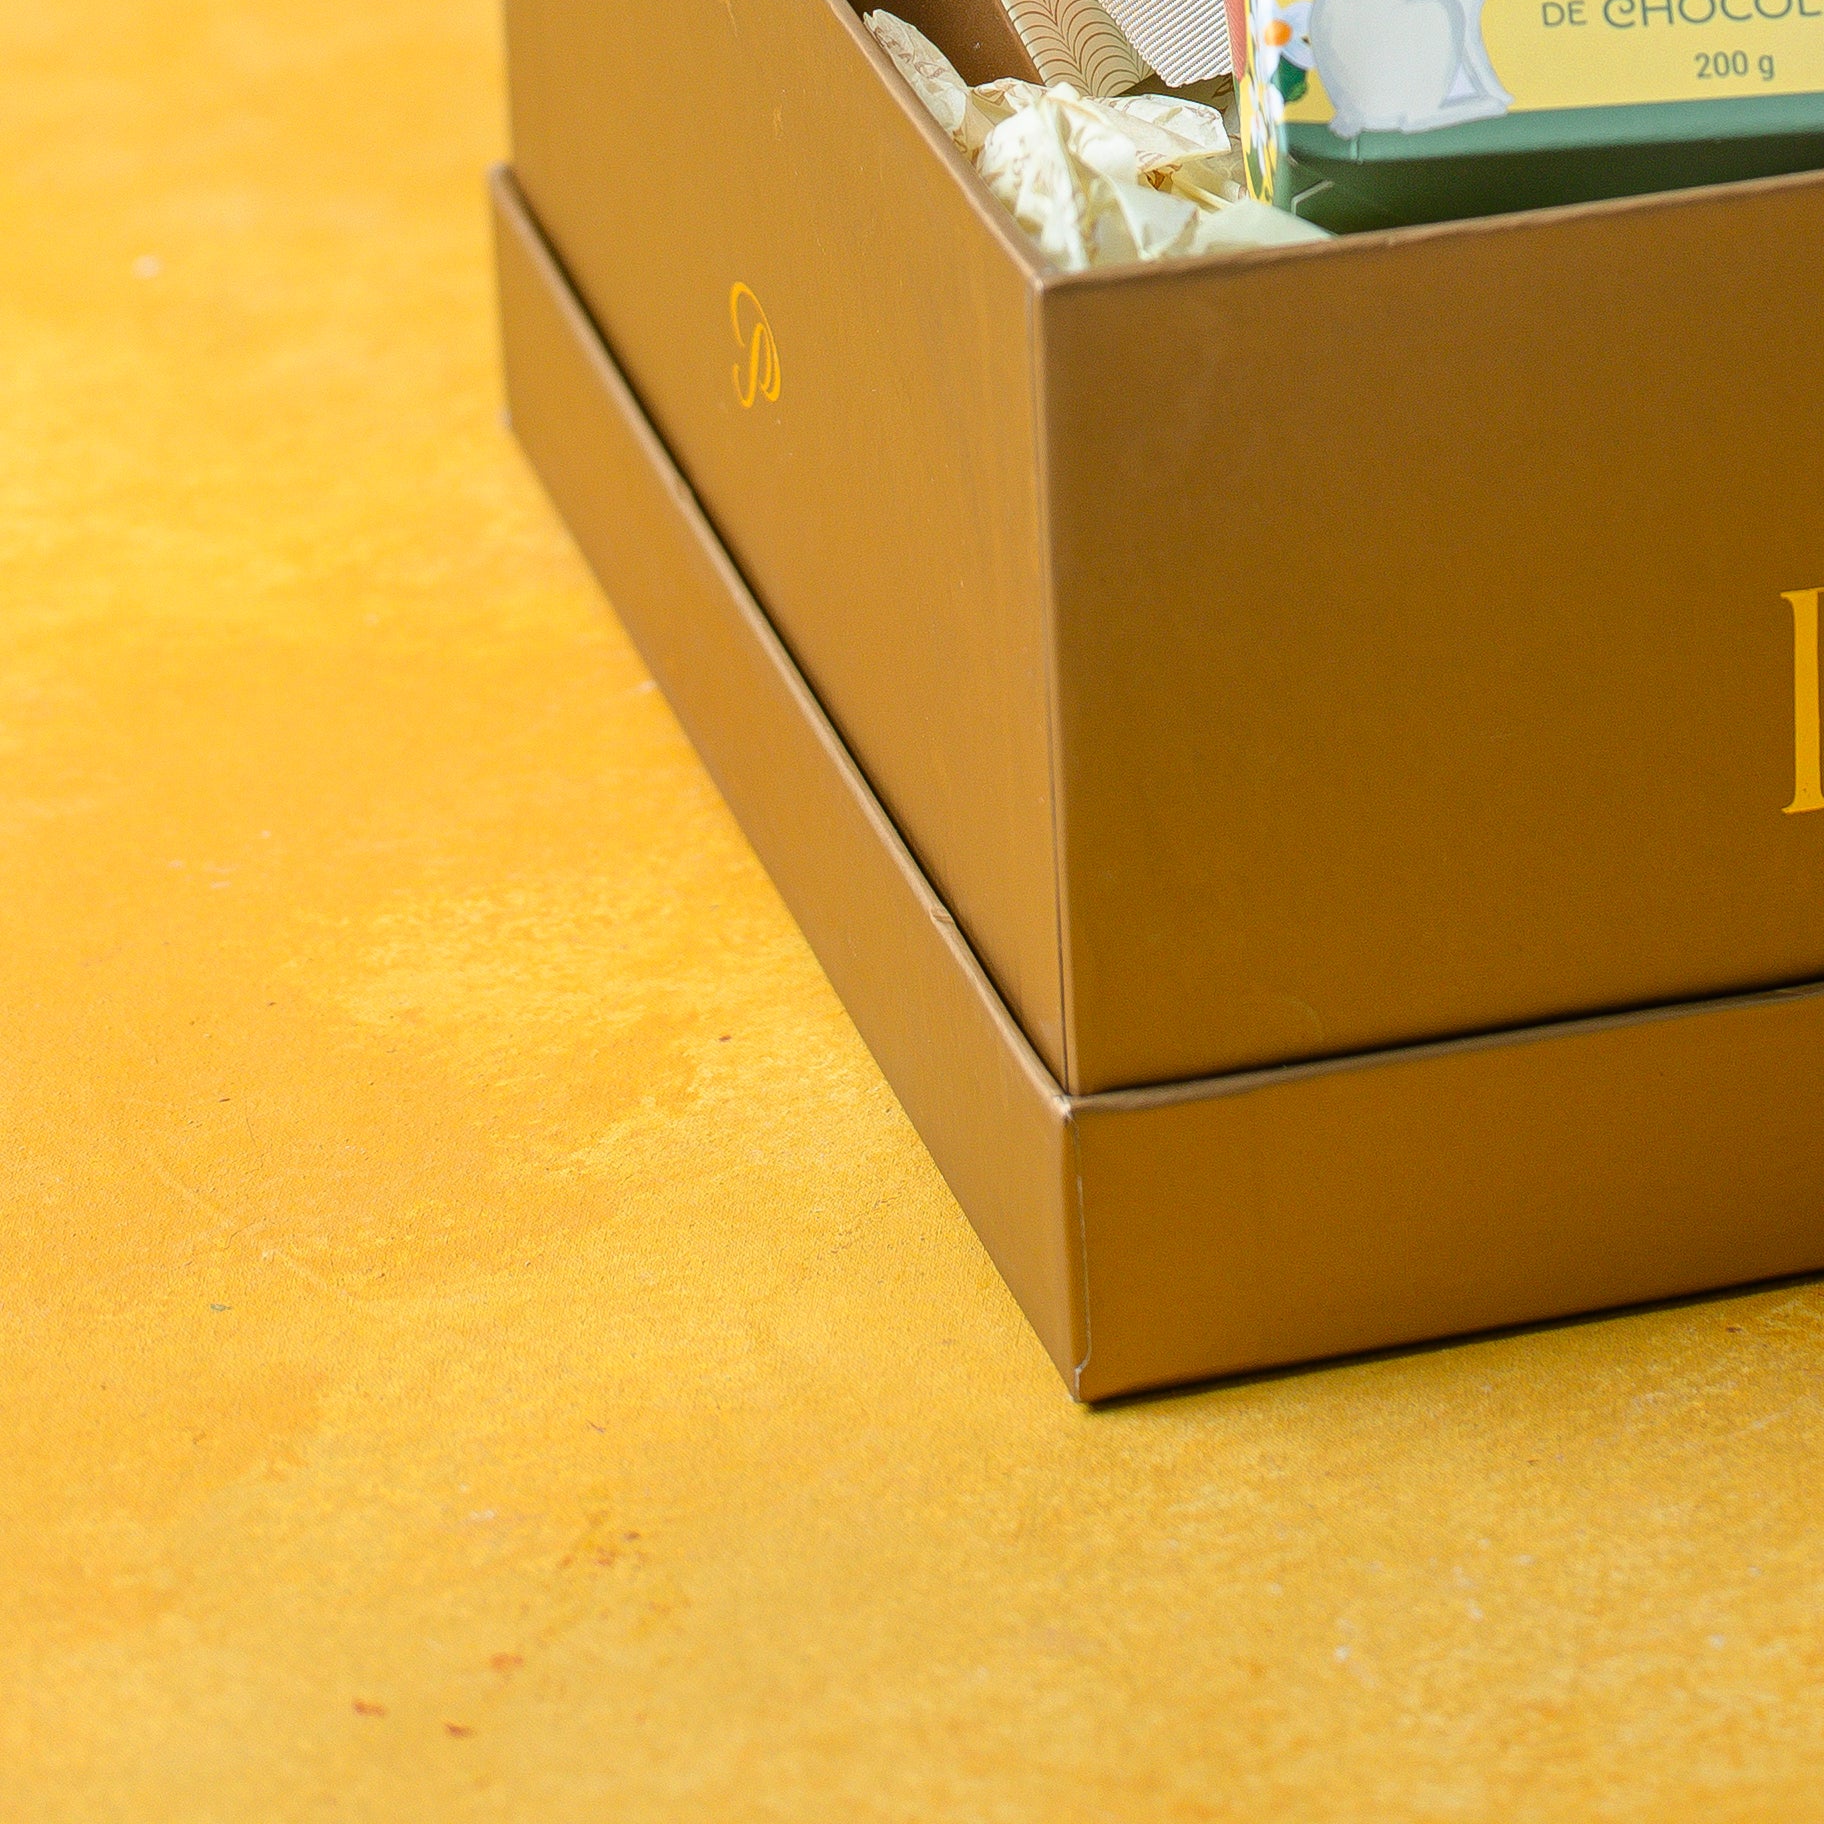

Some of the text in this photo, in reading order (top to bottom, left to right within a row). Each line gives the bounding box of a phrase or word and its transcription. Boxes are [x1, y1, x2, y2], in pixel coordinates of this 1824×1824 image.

[1541, 0, 1589, 29] DE
[1695, 51, 1777, 83] 200 g
